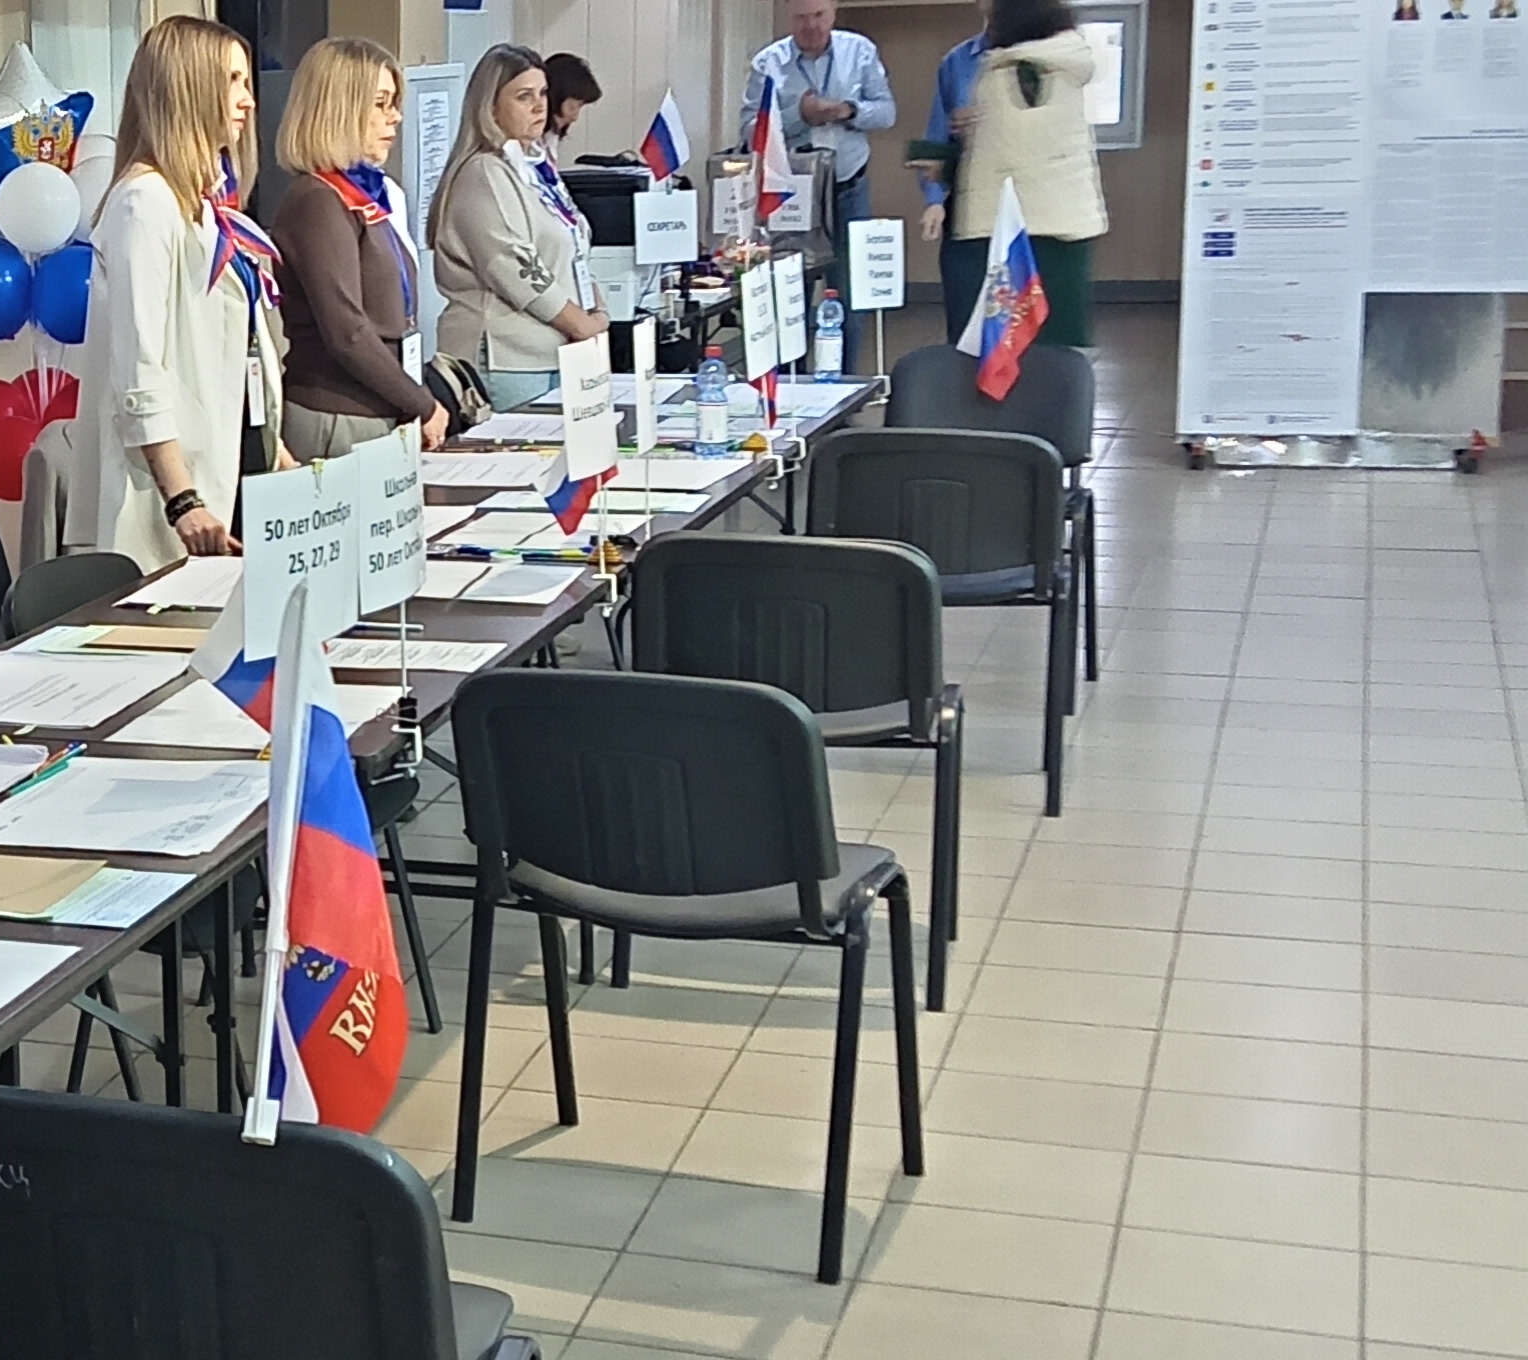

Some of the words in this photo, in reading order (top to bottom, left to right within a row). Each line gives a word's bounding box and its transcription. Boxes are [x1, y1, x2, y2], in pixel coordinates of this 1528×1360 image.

[647, 220, 688, 232] СЕКРЕТАРЬ
[265, 519, 284, 541] 50
[287, 517, 310, 537] лет
[313, 501, 351, 530] Октября
[370, 519, 395, 538] пер.
[288, 552, 309, 574] 25,
[311, 545, 327, 568] 27,
[329, 540, 340, 562] 29
[369, 552, 384, 573] 50
[386, 549, 403, 568] лет
